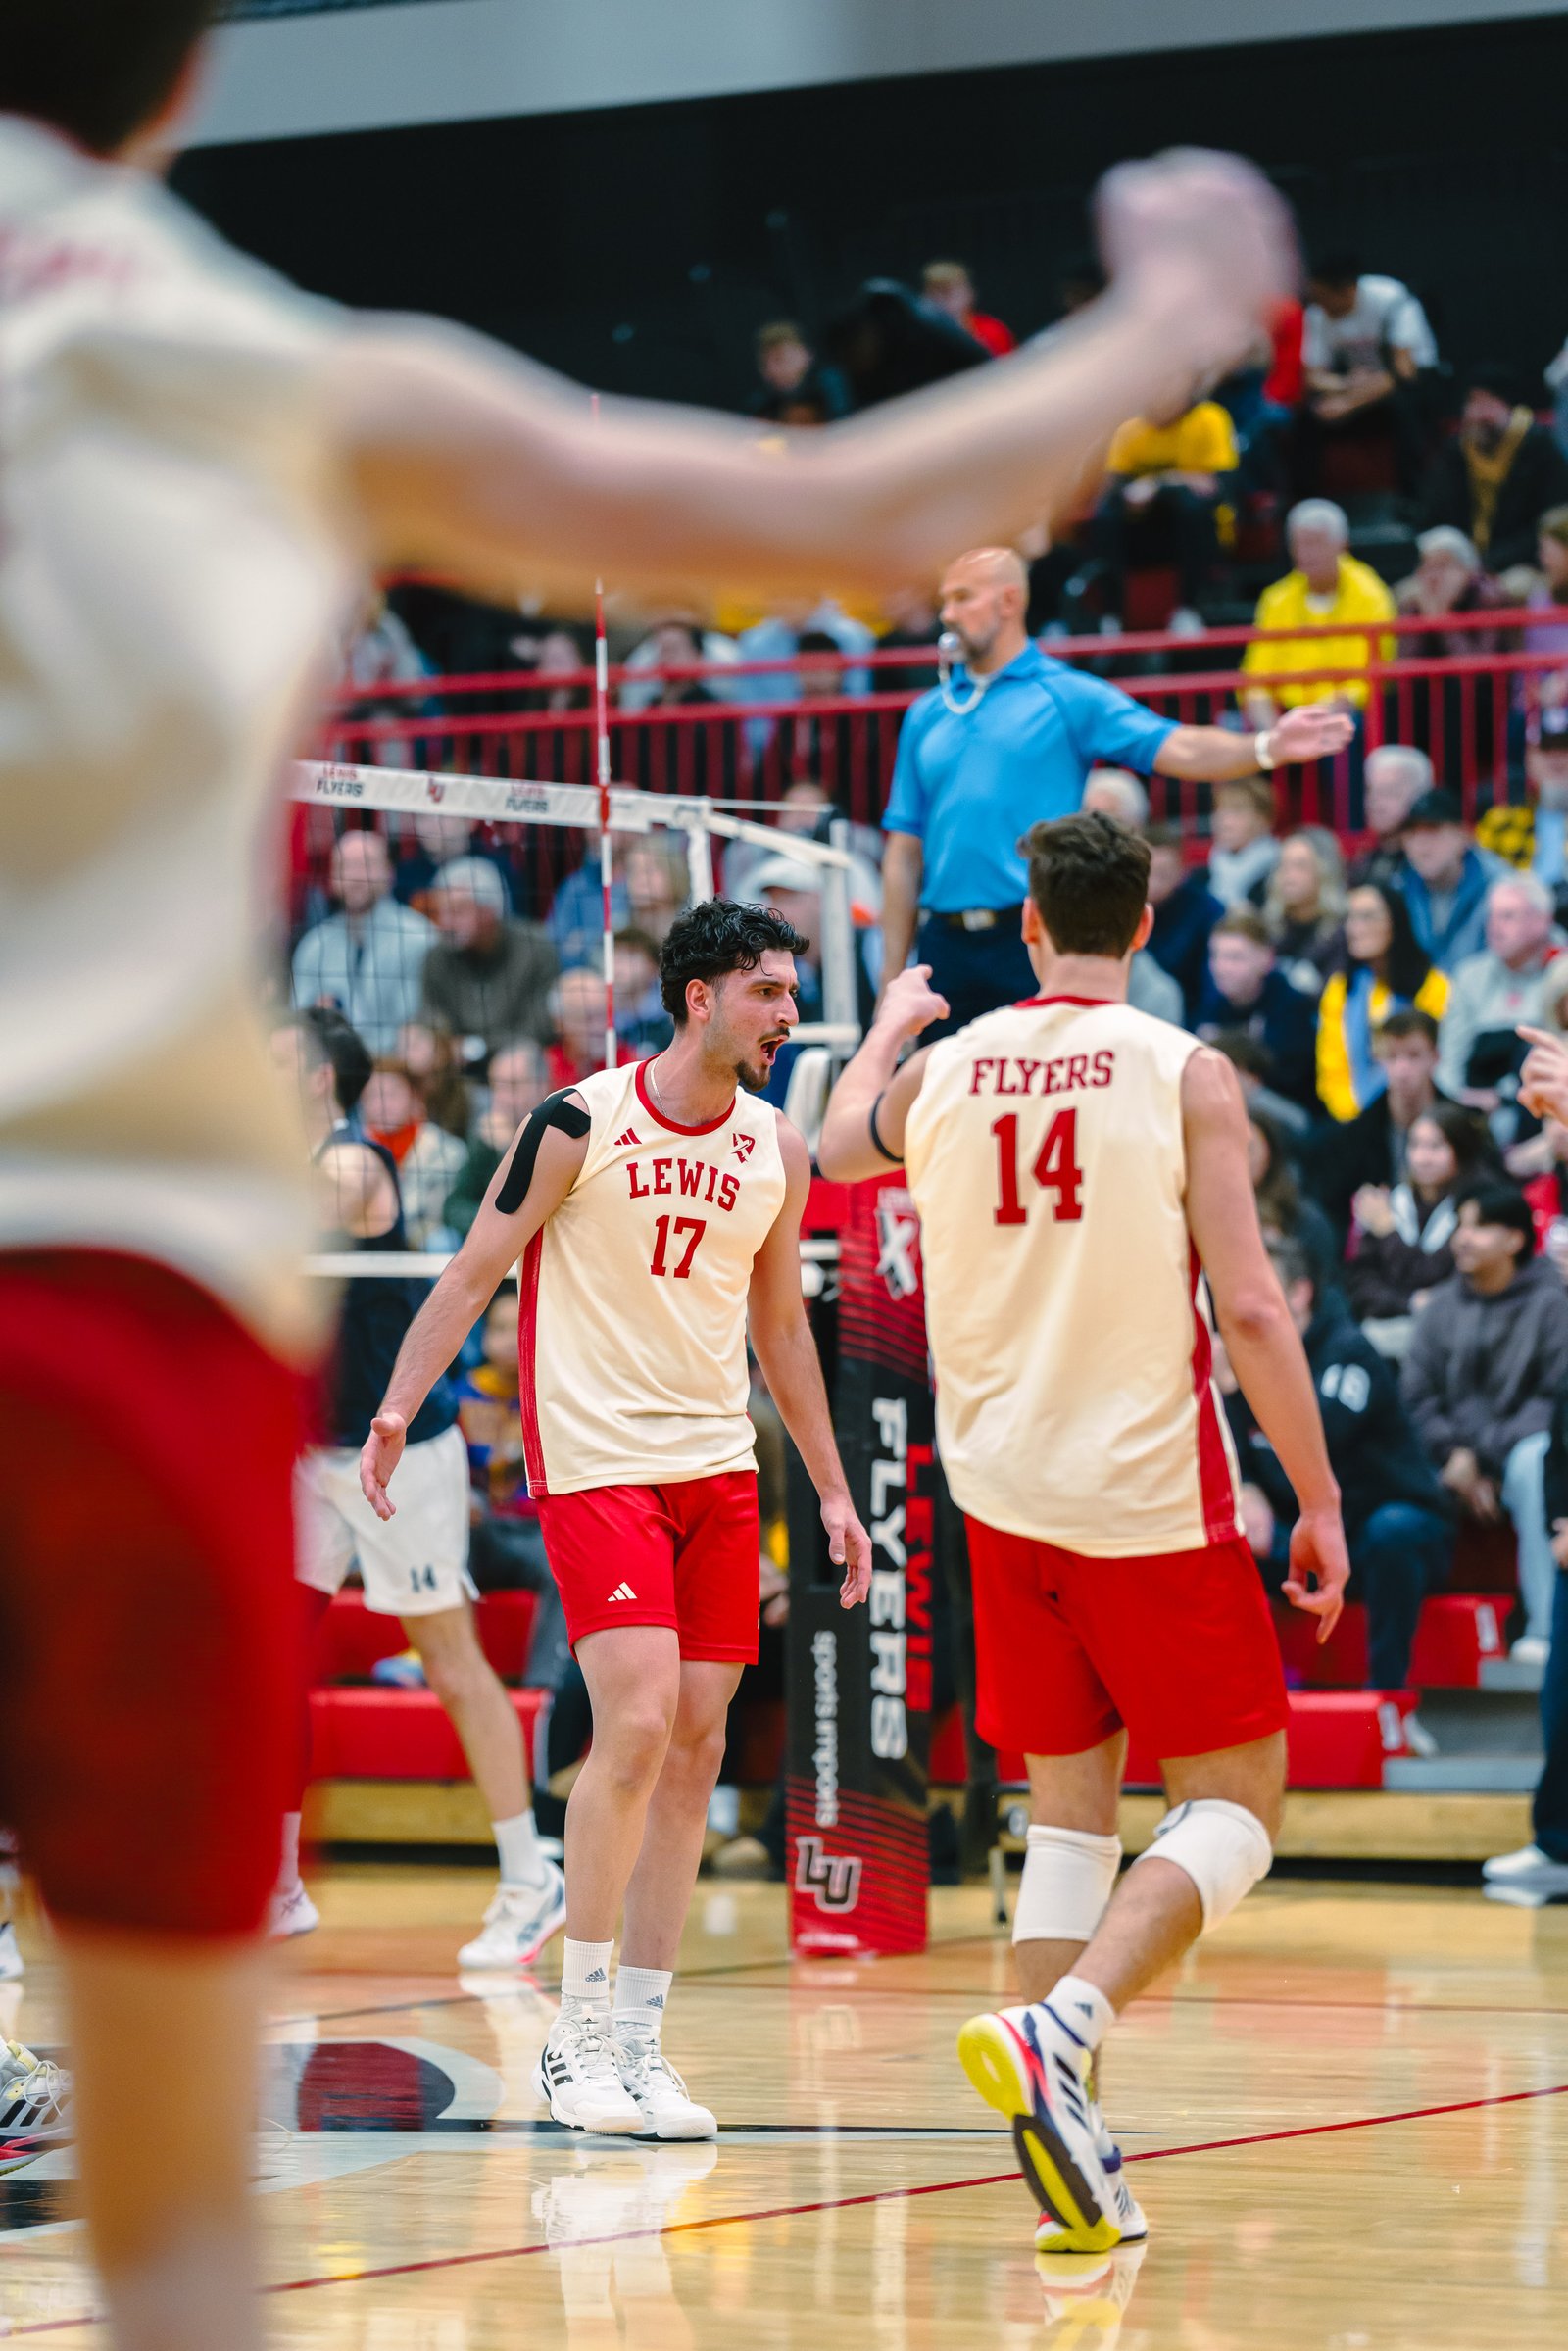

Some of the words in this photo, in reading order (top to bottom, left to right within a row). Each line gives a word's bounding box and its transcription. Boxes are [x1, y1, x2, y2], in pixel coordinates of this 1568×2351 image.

[316, 778, 364, 798] FLYERS
[968, 1049, 1115, 1097] FLYERS
[626, 1157, 740, 1212] LEWIS
[991, 1106, 1084, 1225] 14
[650, 1214, 707, 1279] 17
[409, 1564, 438, 1594] 14
[869, 1396, 908, 1760] FLYERS
[906, 1444, 933, 1711] LEWIS
[810, 1630, 839, 1718] sports
